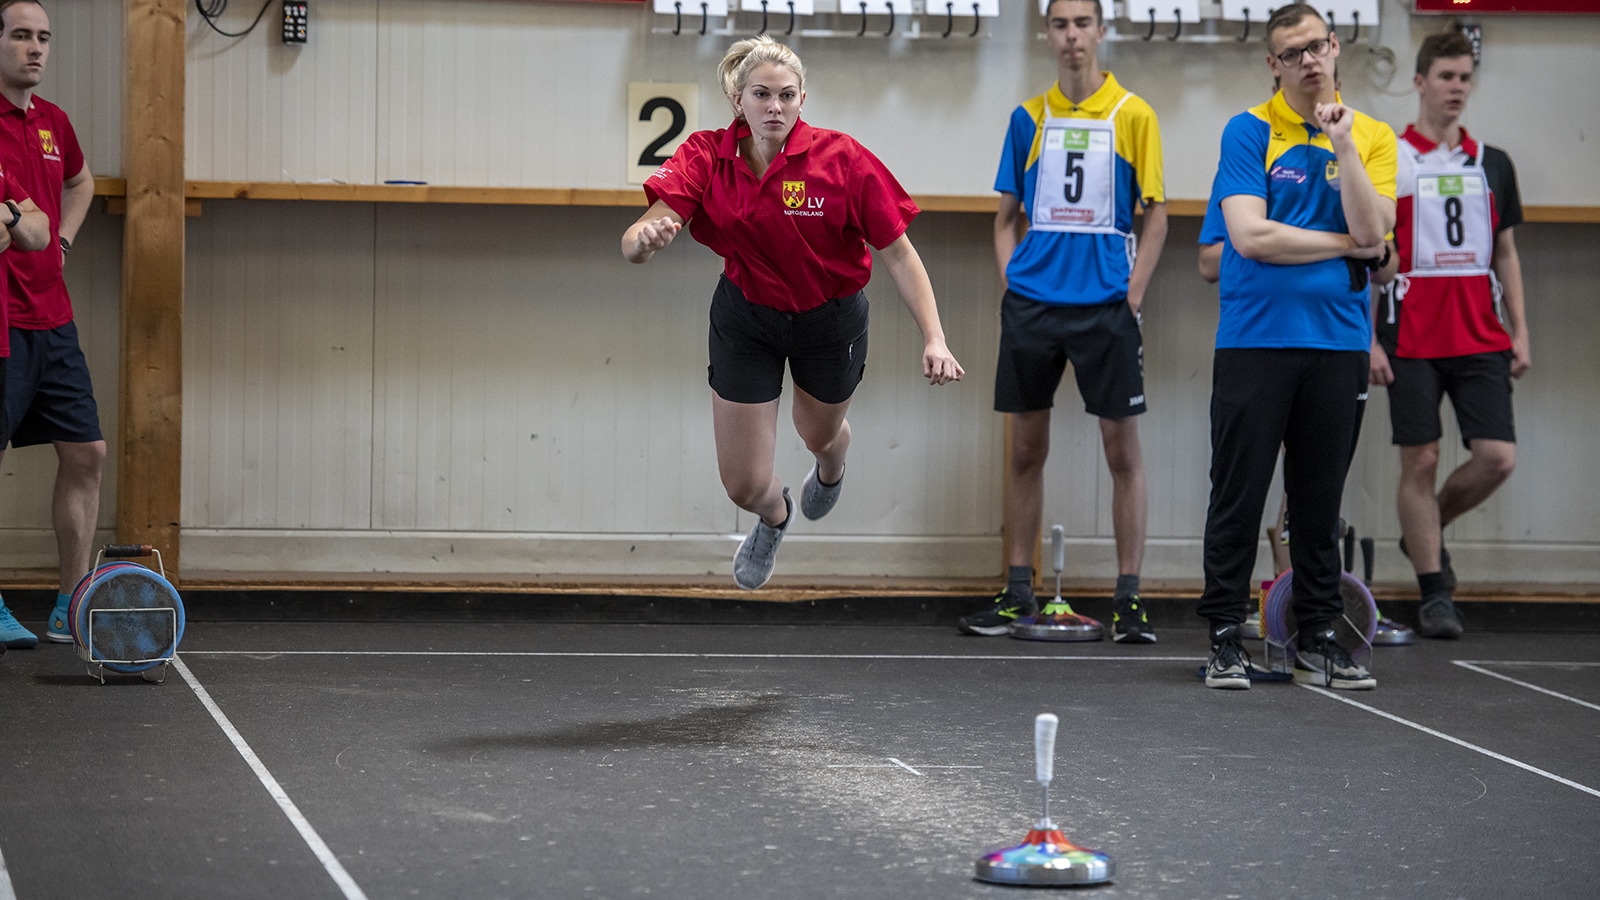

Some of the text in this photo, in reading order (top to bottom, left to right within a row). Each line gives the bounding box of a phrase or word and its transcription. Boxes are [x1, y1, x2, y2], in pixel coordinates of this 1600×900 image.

[638, 96, 687, 166] 2
[807, 196, 825, 209] LV
[1064, 152, 1085, 204] 5
[1444, 196, 1465, 248] 8
